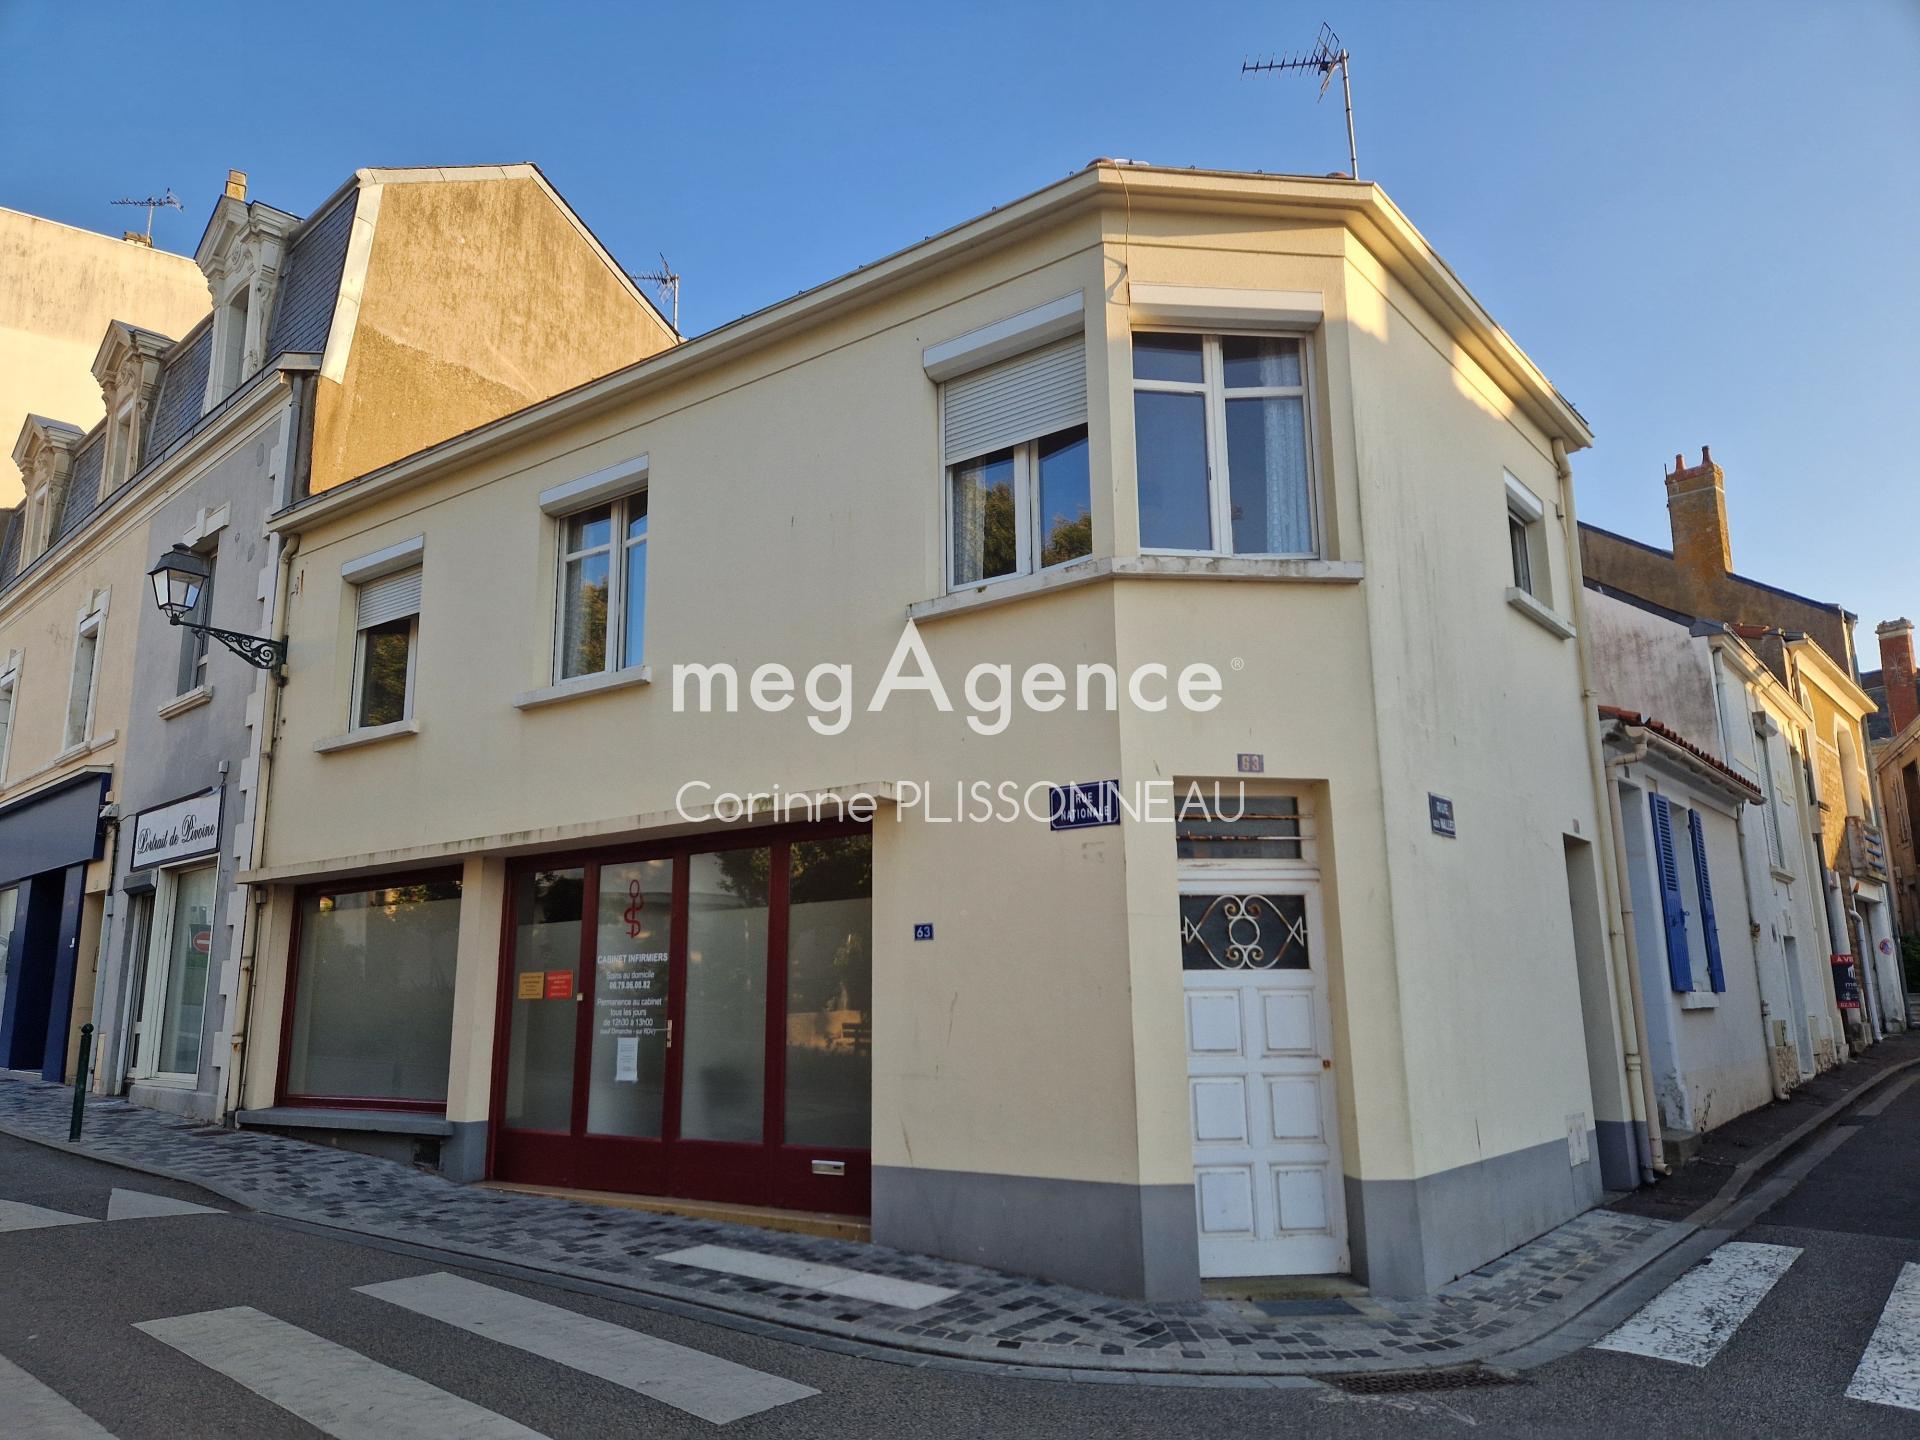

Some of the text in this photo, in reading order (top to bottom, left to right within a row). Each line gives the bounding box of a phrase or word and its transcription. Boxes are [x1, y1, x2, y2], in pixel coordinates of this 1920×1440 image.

[1075, 791, 1093, 805] RUE
[169, 826, 179, 847] de
[181, 814, 216, 843] Pivoine
[916, 926, 931, 938] 63
[597, 952, 668, 964] CABINET INFIRMIERS
[631, 969, 655, 978] domicile
[597, 998, 632, 1007] Permanence
[641, 998, 662, 1006] cabinet
